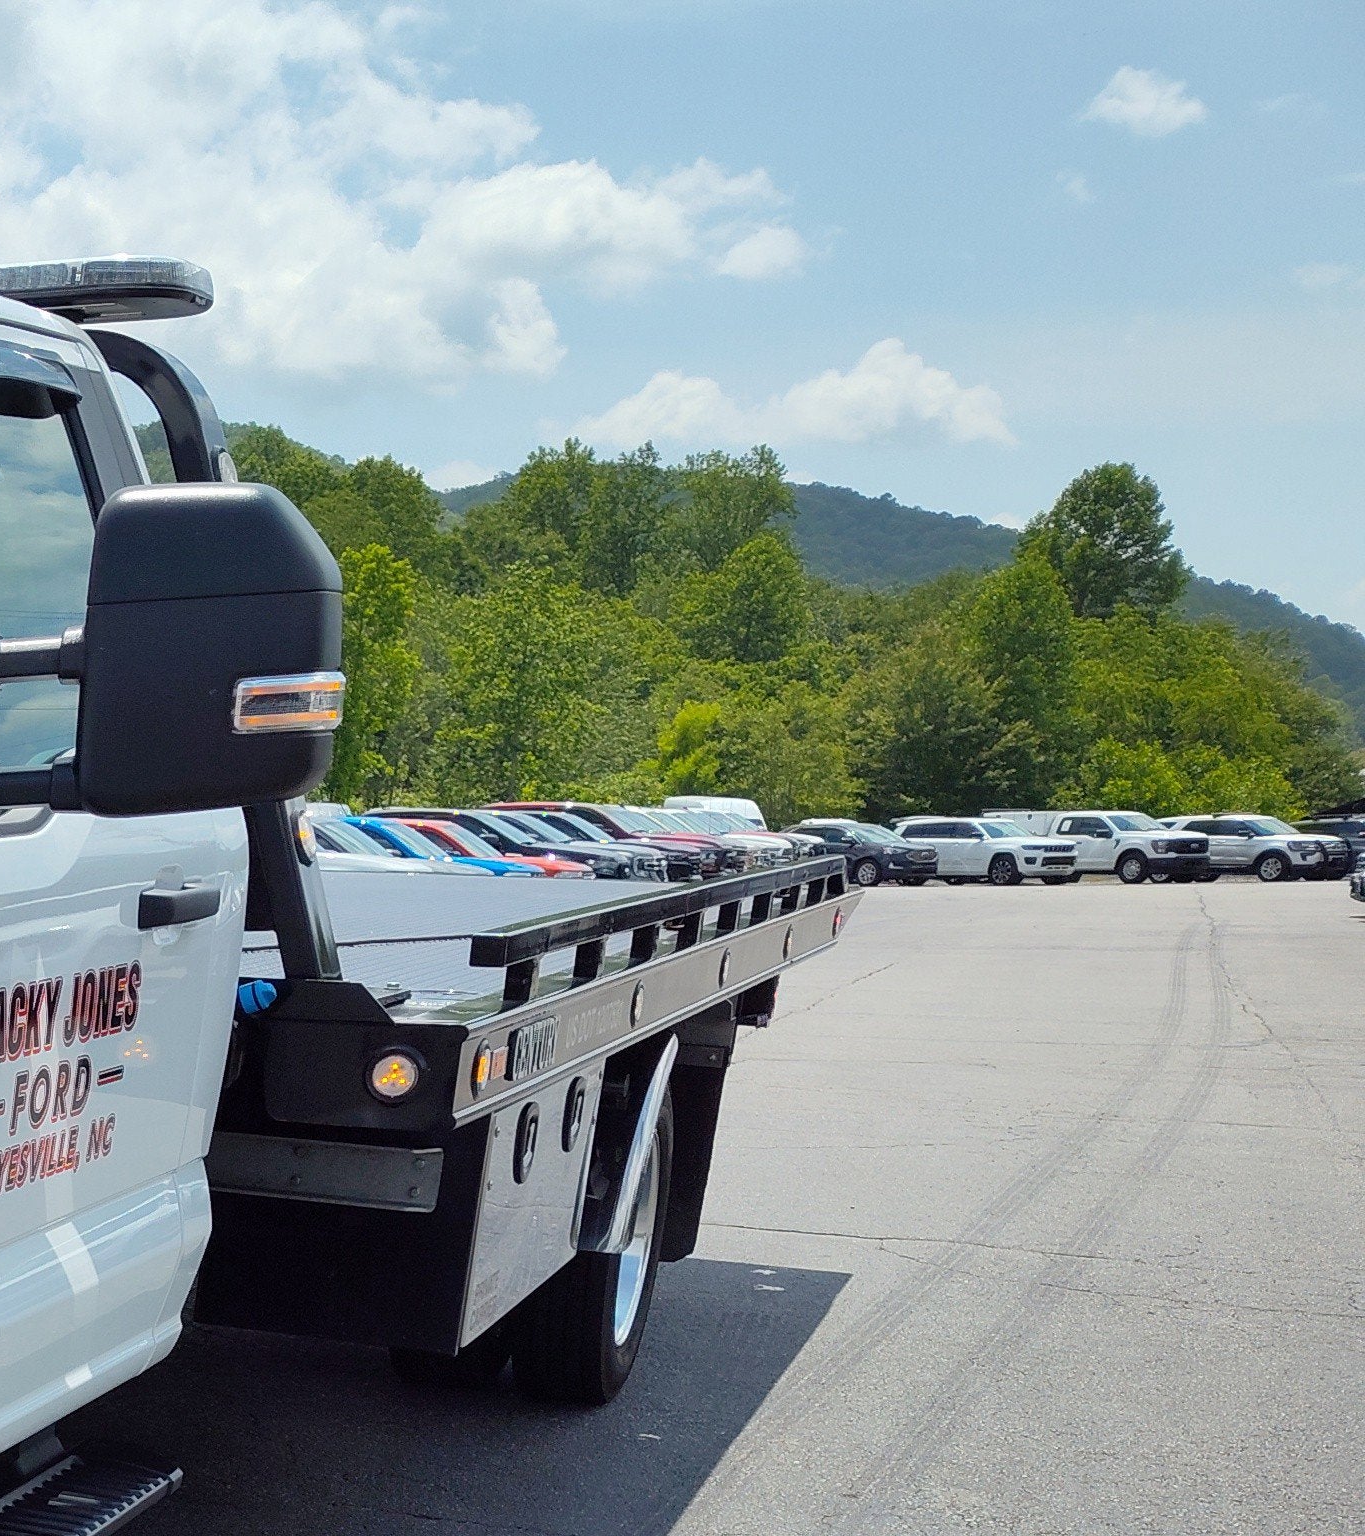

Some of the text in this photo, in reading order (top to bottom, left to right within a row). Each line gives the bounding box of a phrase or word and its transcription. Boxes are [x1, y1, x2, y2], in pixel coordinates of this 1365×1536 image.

[62, 958, 142, 1049] JONES
[8, 1053, 93, 1137] FORD
[85, 1112, 117, 1163] NC
